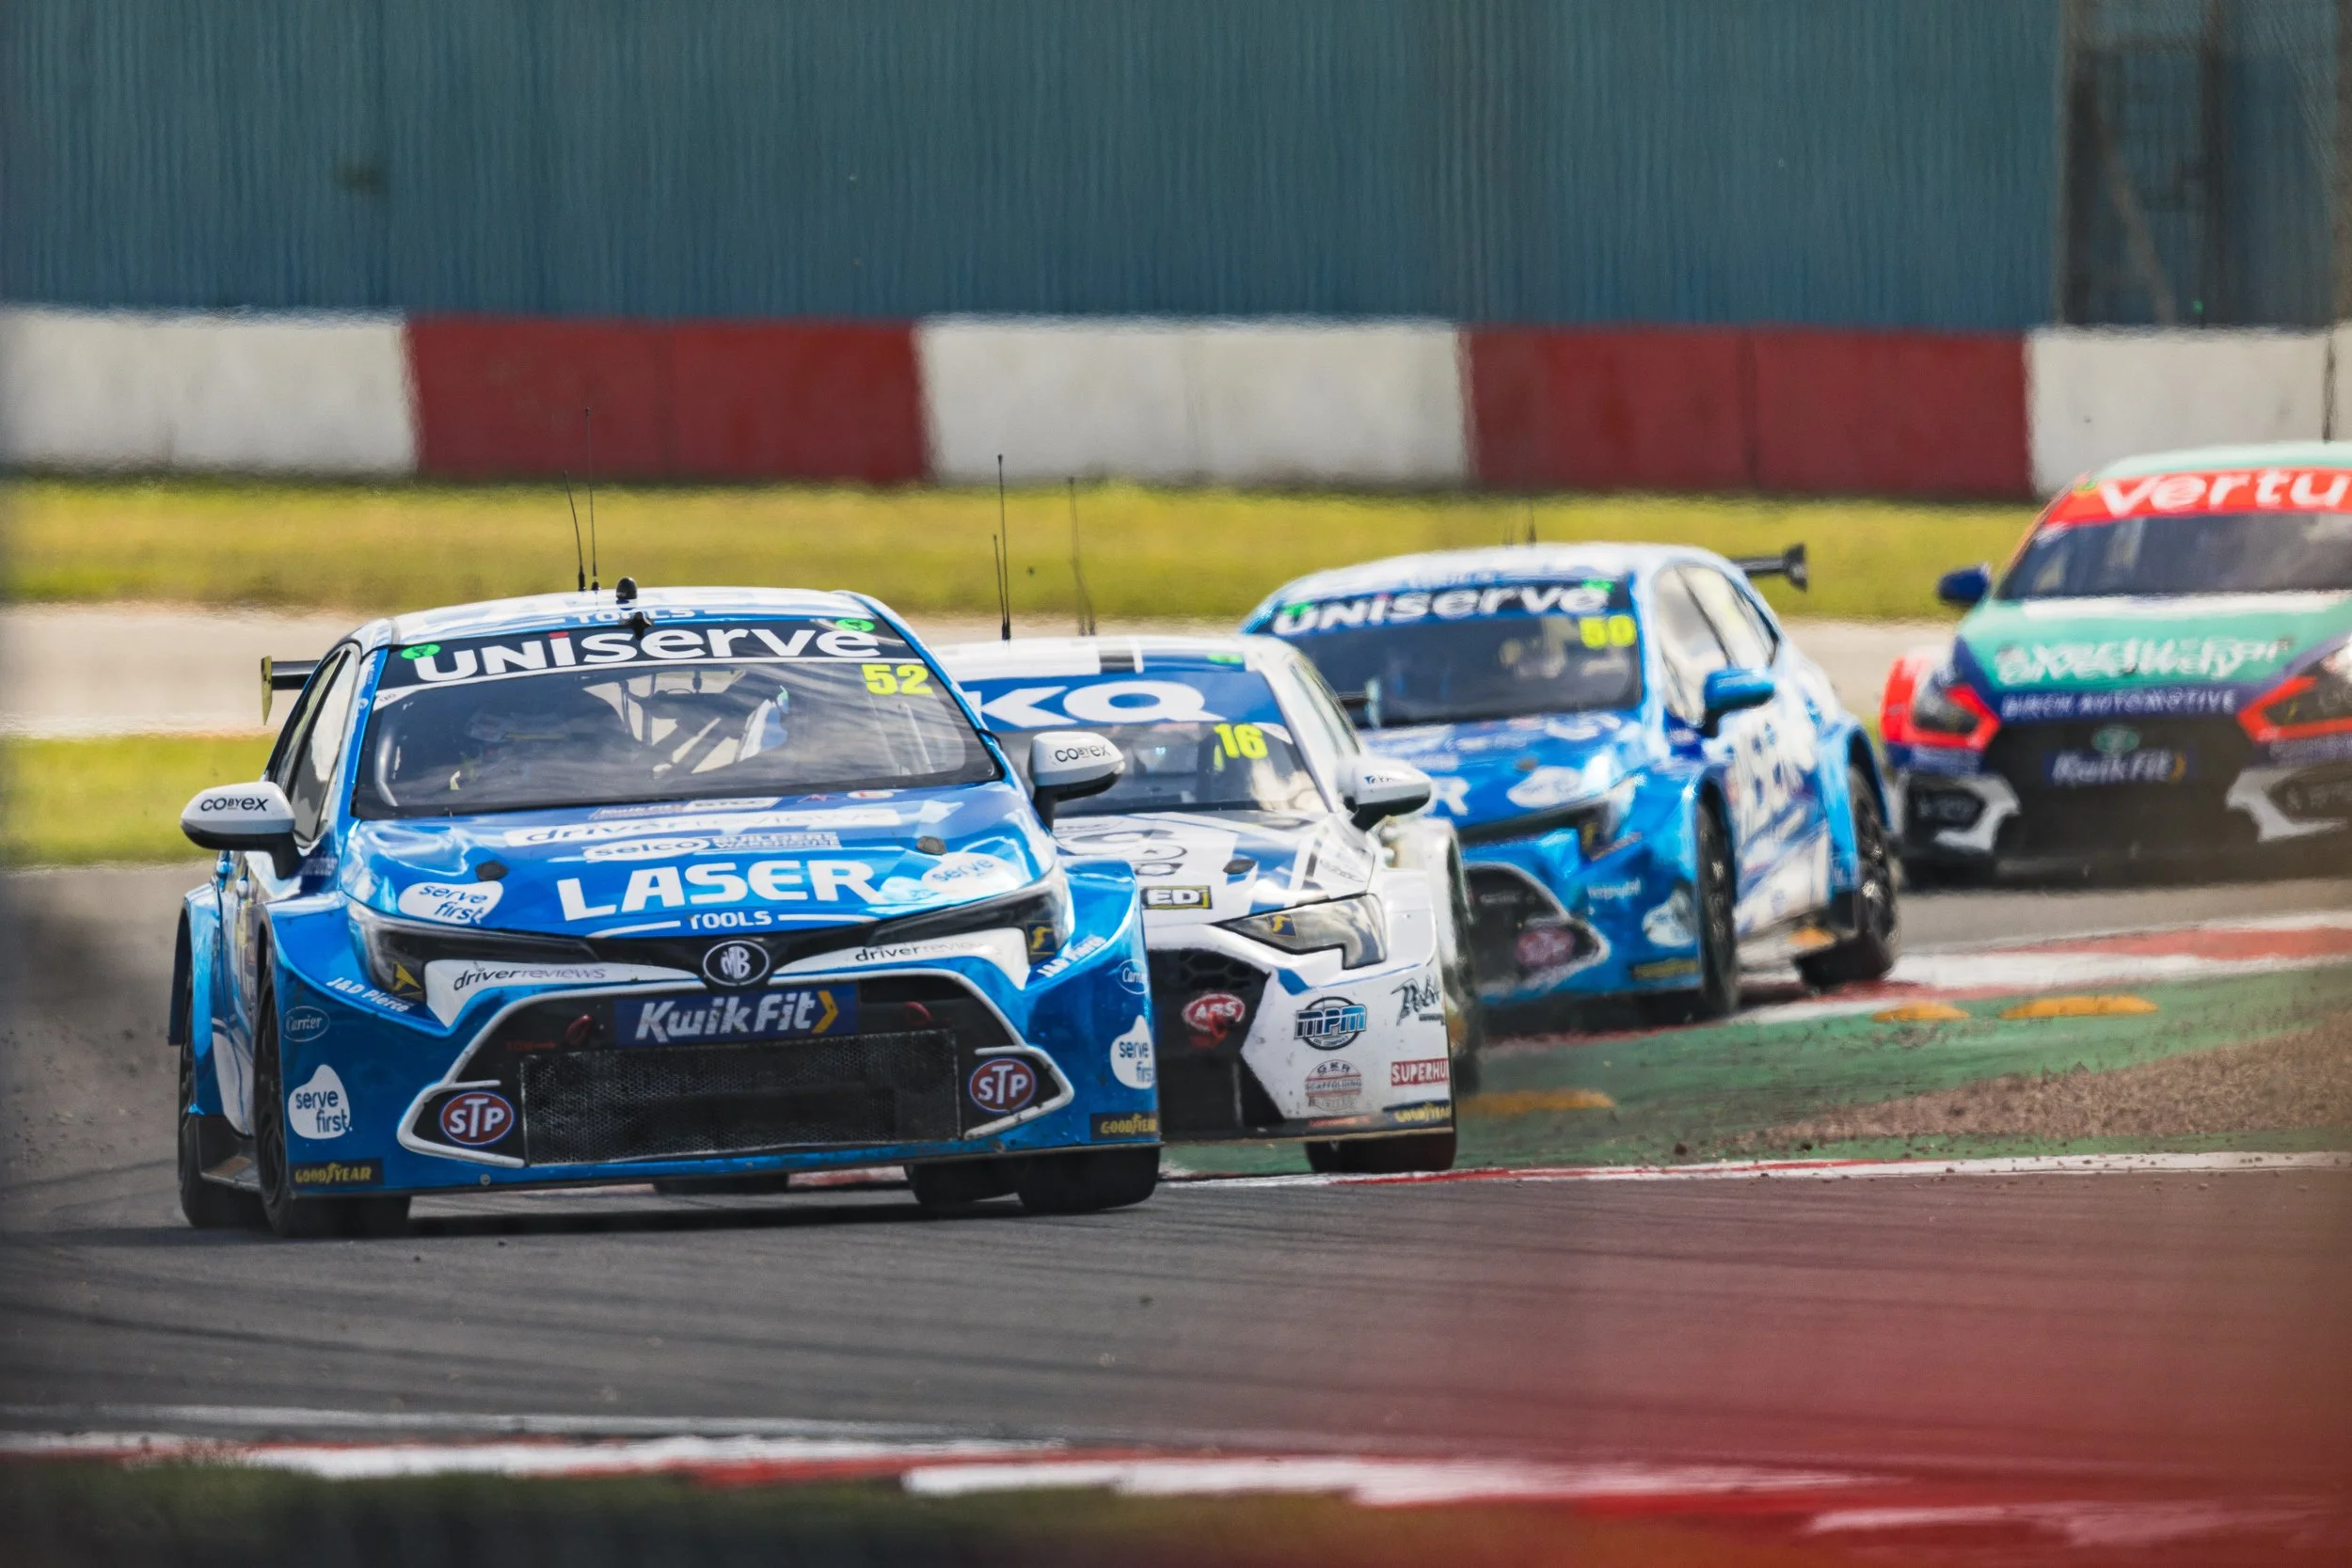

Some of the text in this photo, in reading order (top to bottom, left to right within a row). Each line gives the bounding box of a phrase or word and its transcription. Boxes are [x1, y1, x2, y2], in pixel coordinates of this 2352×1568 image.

[861, 663, 933, 695] 52
[2077, 688, 2238, 718] AUTOMOTIVE
[1214, 723, 1268, 760] 16
[595, 840, 700, 856] selco
[419, 885, 487, 903] serve
[557, 860, 889, 922] LASER
[689, 911, 772, 930] TOOLS
[453, 967, 606, 990] driverreviews
[326, 976, 363, 996] J&D
[361, 988, 411, 1013] Pierce
[285, 1015, 323, 1033] Carrier
[978, 1064, 1029, 1104] STP
[295, 1089, 339, 1110] serve
[450, 1098, 505, 1138] STP
[294, 1162, 373, 1185] GOODYEAR
